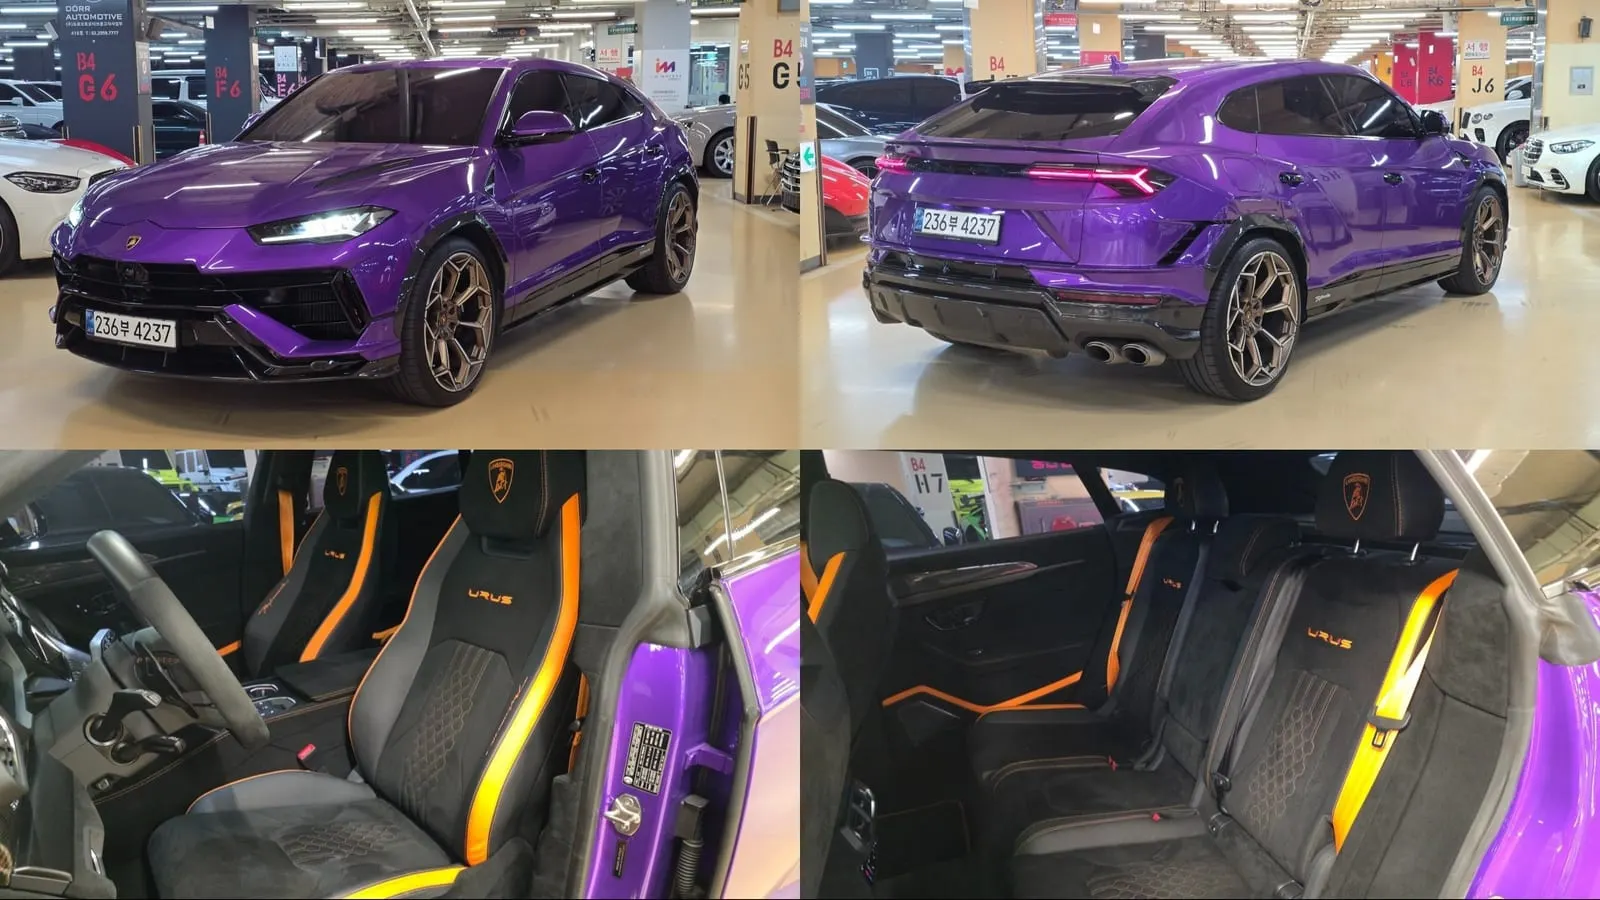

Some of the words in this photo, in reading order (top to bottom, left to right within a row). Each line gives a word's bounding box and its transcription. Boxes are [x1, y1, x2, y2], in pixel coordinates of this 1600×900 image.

[773, 39, 793, 58] B4
[77, 52, 95, 71] B4
[990, 56, 1005, 71] B4
[1472, 65, 1483, 76] B4
[214, 67, 227, 79] B4
[276, 73, 287, 83] B4
[738, 63, 750, 90] G5
[772, 62, 800, 89] G
[1428, 75, 1444, 86] K6
[79, 73, 118, 101] G6
[215, 80, 241, 98] F6
[277, 82, 296, 97] E6
[1471, 78, 1494, 93] J6
[923, 212, 958, 232] 236부
[961, 216, 996, 237] 4237
[95, 315, 130, 337] 236부
[133, 320, 171, 343] 4237
[910, 458, 926, 472] B4
[914, 474, 943, 494] H7
[468, 588, 513, 605] URUS
[1308, 627, 1353, 649] URUS
